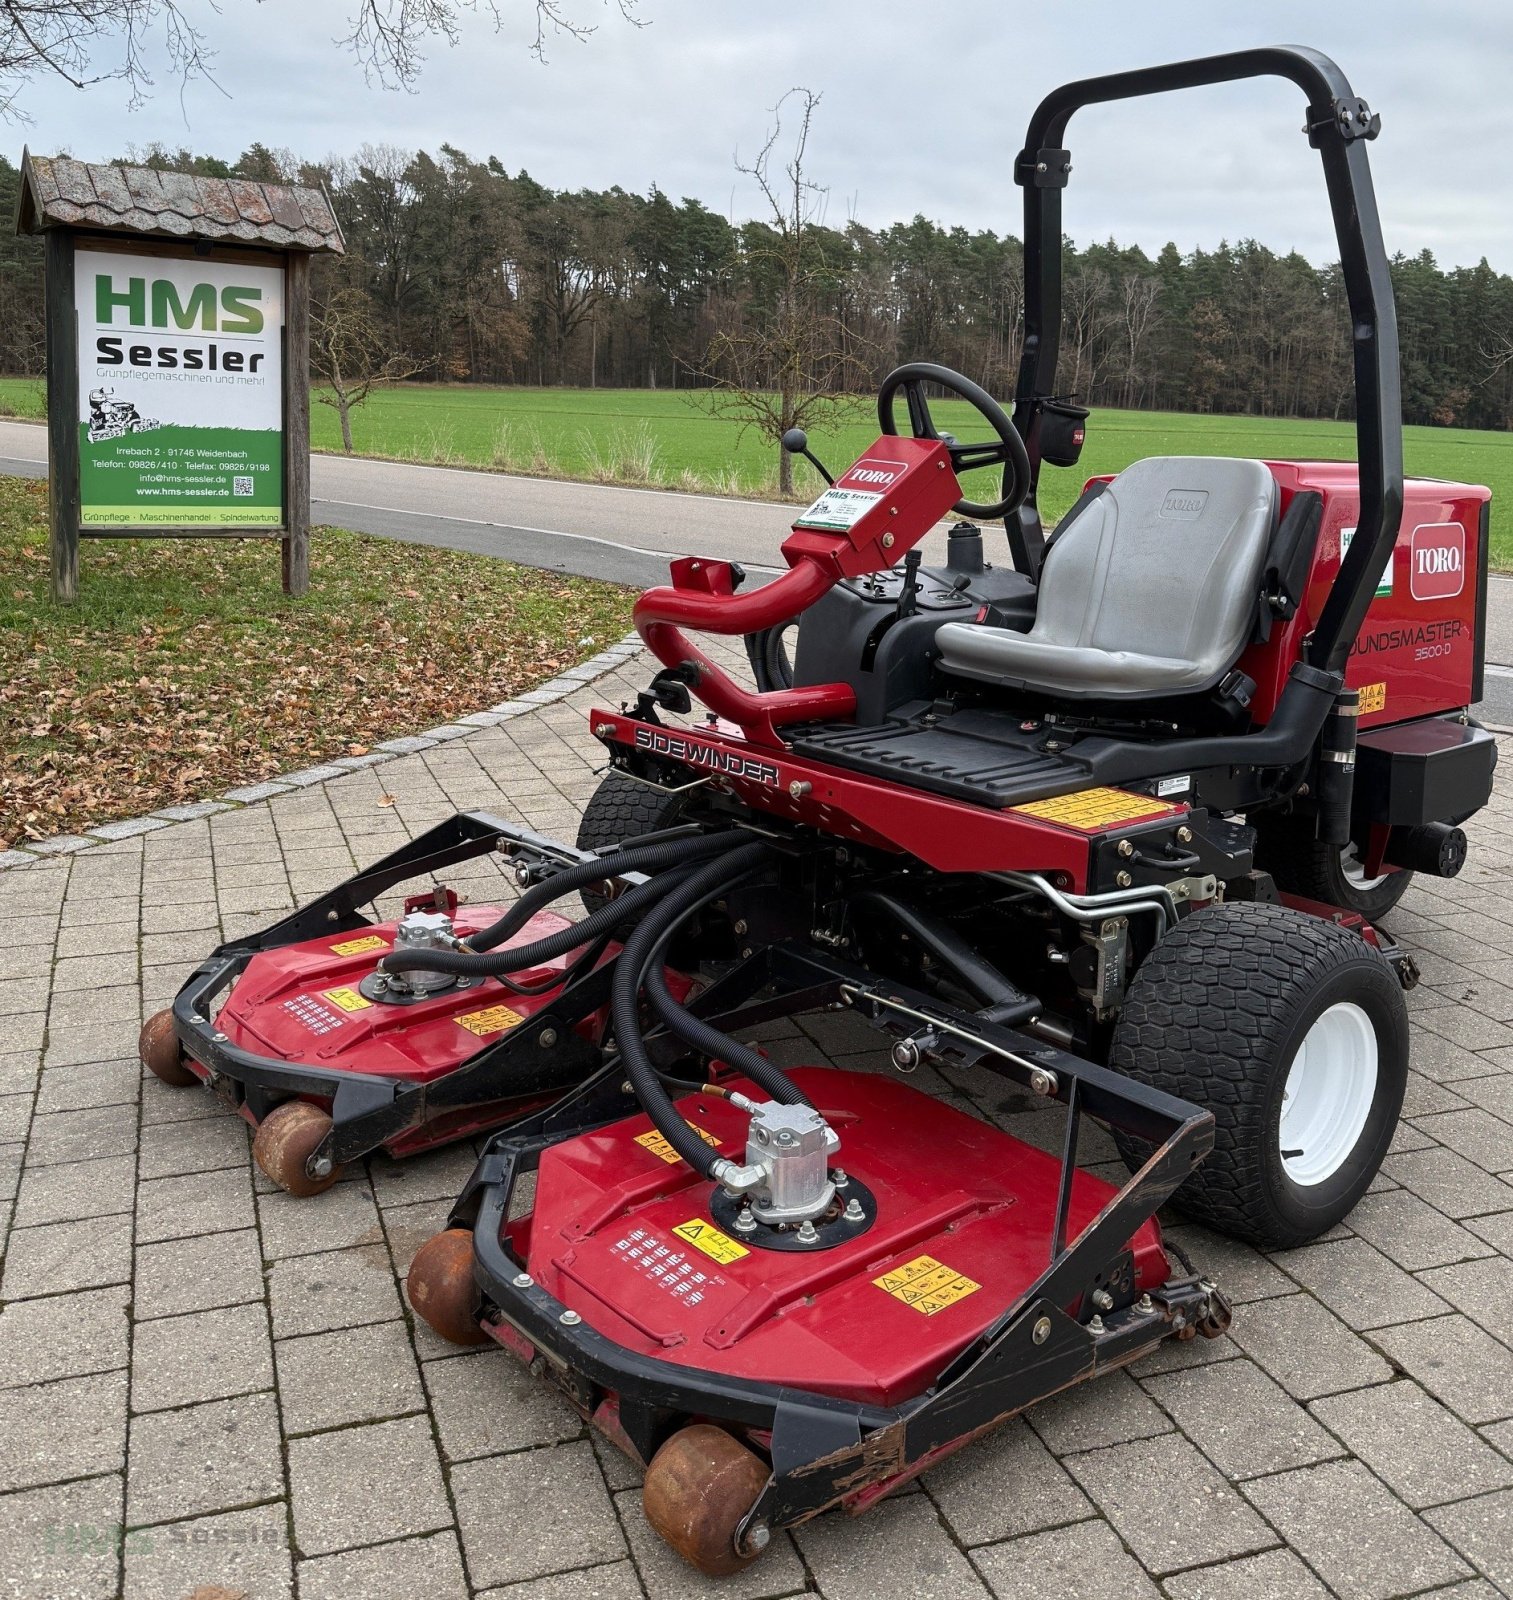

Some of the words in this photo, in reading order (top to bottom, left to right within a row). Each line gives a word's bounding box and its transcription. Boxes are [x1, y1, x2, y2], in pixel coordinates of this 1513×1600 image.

[96, 274, 264, 334] HMS
[96, 337, 265, 373] Sessler
[215, 376, 235, 385] und
[237, 377, 265, 386] mehr!
[116, 447, 152, 456] Irrebach
[154, 448, 160, 456] 2
[167, 448, 195, 457] 91746
[196, 449, 248, 458] Weidenbach
[92, 459, 126, 468] Telefon:
[128, 460, 178, 469] 09826/410
[185, 461, 217, 470] Telefax:
[219, 463, 270, 471] 09826/9198
[139, 474, 227, 483] info@hms-sessler.de
[136, 487, 230, 496] www.hms-sessler.de
[83, 513, 130, 522] Grünpflege
[139, 513, 211, 521] Maschinenhandel
[219, 513, 279, 522] Spindelwartung
[635, 727, 780, 788] SIDEWINDER
